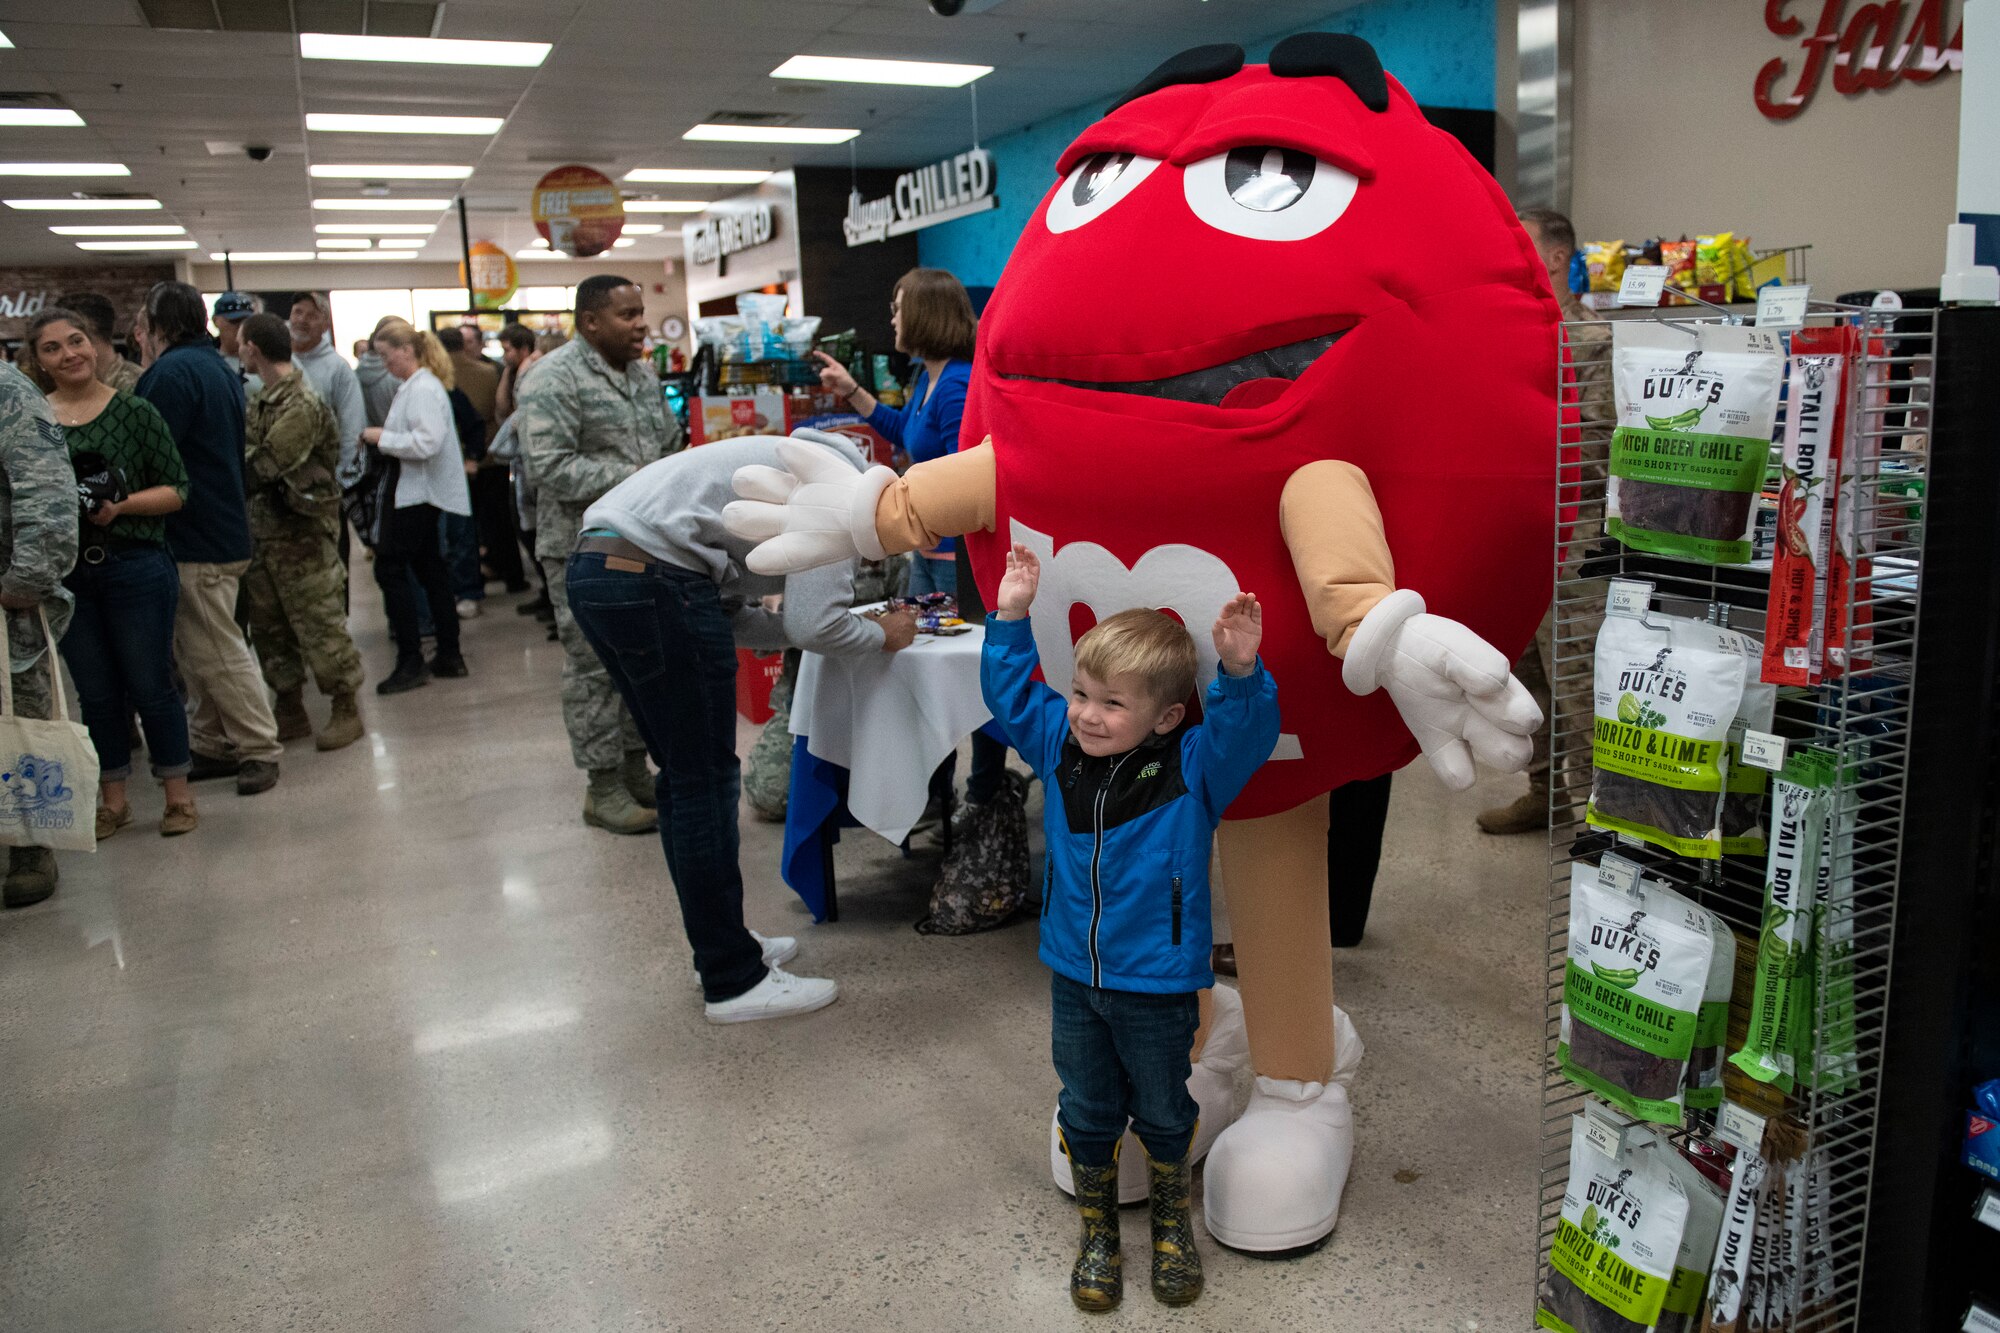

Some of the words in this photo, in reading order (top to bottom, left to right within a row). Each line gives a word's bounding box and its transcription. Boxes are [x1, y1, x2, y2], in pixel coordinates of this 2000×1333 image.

[895, 149, 990, 221] CHILLED
[1627, 281, 1646, 290] 15.99
[1766, 306, 1783, 315] 1.79
[1727, 413, 1751, 423] NITRITES
[1799, 391, 1823, 438] TALL
[1654, 436, 1696, 458] GREEN
[1700, 441, 1745, 462] CHILE
[1644, 459, 1688, 472] SHORTY
[1690, 465, 1739, 477] SAUSAGES
[1796, 443, 1817, 485] BOY
[1791, 568, 1806, 591] HOT
[1613, 596, 1631, 606] 15.99
[1785, 607, 1801, 641] SPICY
[1694, 715, 1717, 726] NITRITES
[1612, 749, 1652, 768] SHORTY
[1646, 733, 1658, 755] &
[1660, 736, 1711, 765] LIME
[1750, 745, 1766, 756] 1.79
[1662, 982, 1683, 995] NITRITES
[1766, 963, 1780, 993] HATCH
[1595, 985, 1633, 1016] GREEN
[1635, 1003, 1677, 1032] CHILE
[1763, 994, 1776, 1022] GREEN
[1585, 1001, 1624, 1027] SHORTY
[1626, 1022, 1669, 1045] SAUSAGES
[1760, 1023, 1774, 1052] CHILE
[1589, 1128, 1606, 1143] 15.99
[1725, 1116, 1741, 1131] 1.79
[1566, 1255, 1597, 1281] SHORTY
[1597, 1278, 1633, 1305] SAUSAGES
[1596, 1251, 1609, 1273] &
[1605, 1256, 1647, 1297] LIME
